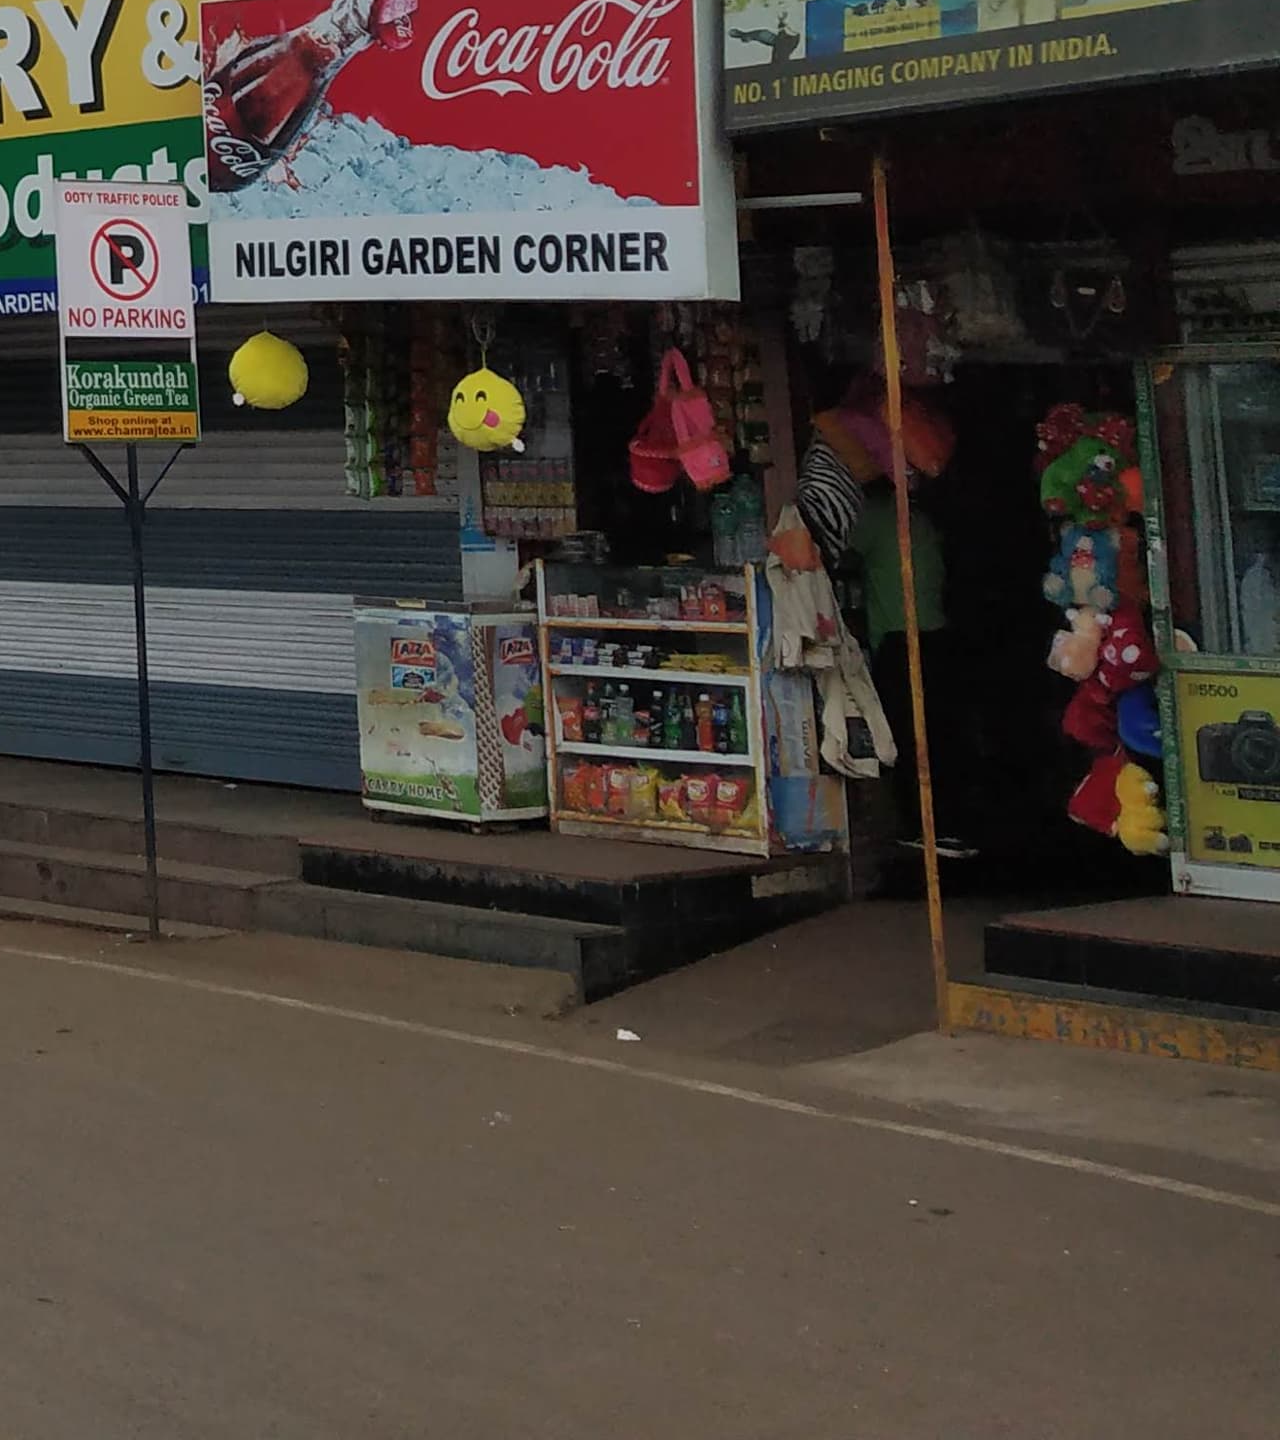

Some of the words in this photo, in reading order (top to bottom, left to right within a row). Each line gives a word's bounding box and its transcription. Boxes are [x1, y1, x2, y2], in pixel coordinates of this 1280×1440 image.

[733, 83, 767, 105] NO.
[791, 64, 885, 98] IMAGING
[890, 46, 1001, 83] COMPANY
[1008, 44, 1033, 67] IN
[1040, 32, 1118, 64] INDIA.
[64, 190, 94, 205] OOTY
[97, 191, 140, 206] TRAFFIC
[142, 193, 180, 208] POLICE
[235, 238, 351, 279] NILGIRI
[361, 234, 502, 275] GARDEN
[513, 231, 670, 274] CORNER
[68, 307, 97, 328] NO
[102, 307, 187, 330] PARKING
[66, 364, 190, 390] Korakundah
[69, 389, 121, 410] Organic
[123, 389, 164, 407] Green
[165, 390, 189, 407] Tea
[73, 424, 192, 438] www.chamrajtea.in
[87, 415, 119, 427] Shop
[123, 415, 159, 426] online
[160, 416, 173, 426] at
[368, 778, 405, 794] CARRY
[408, 783, 444, 800] HOME
